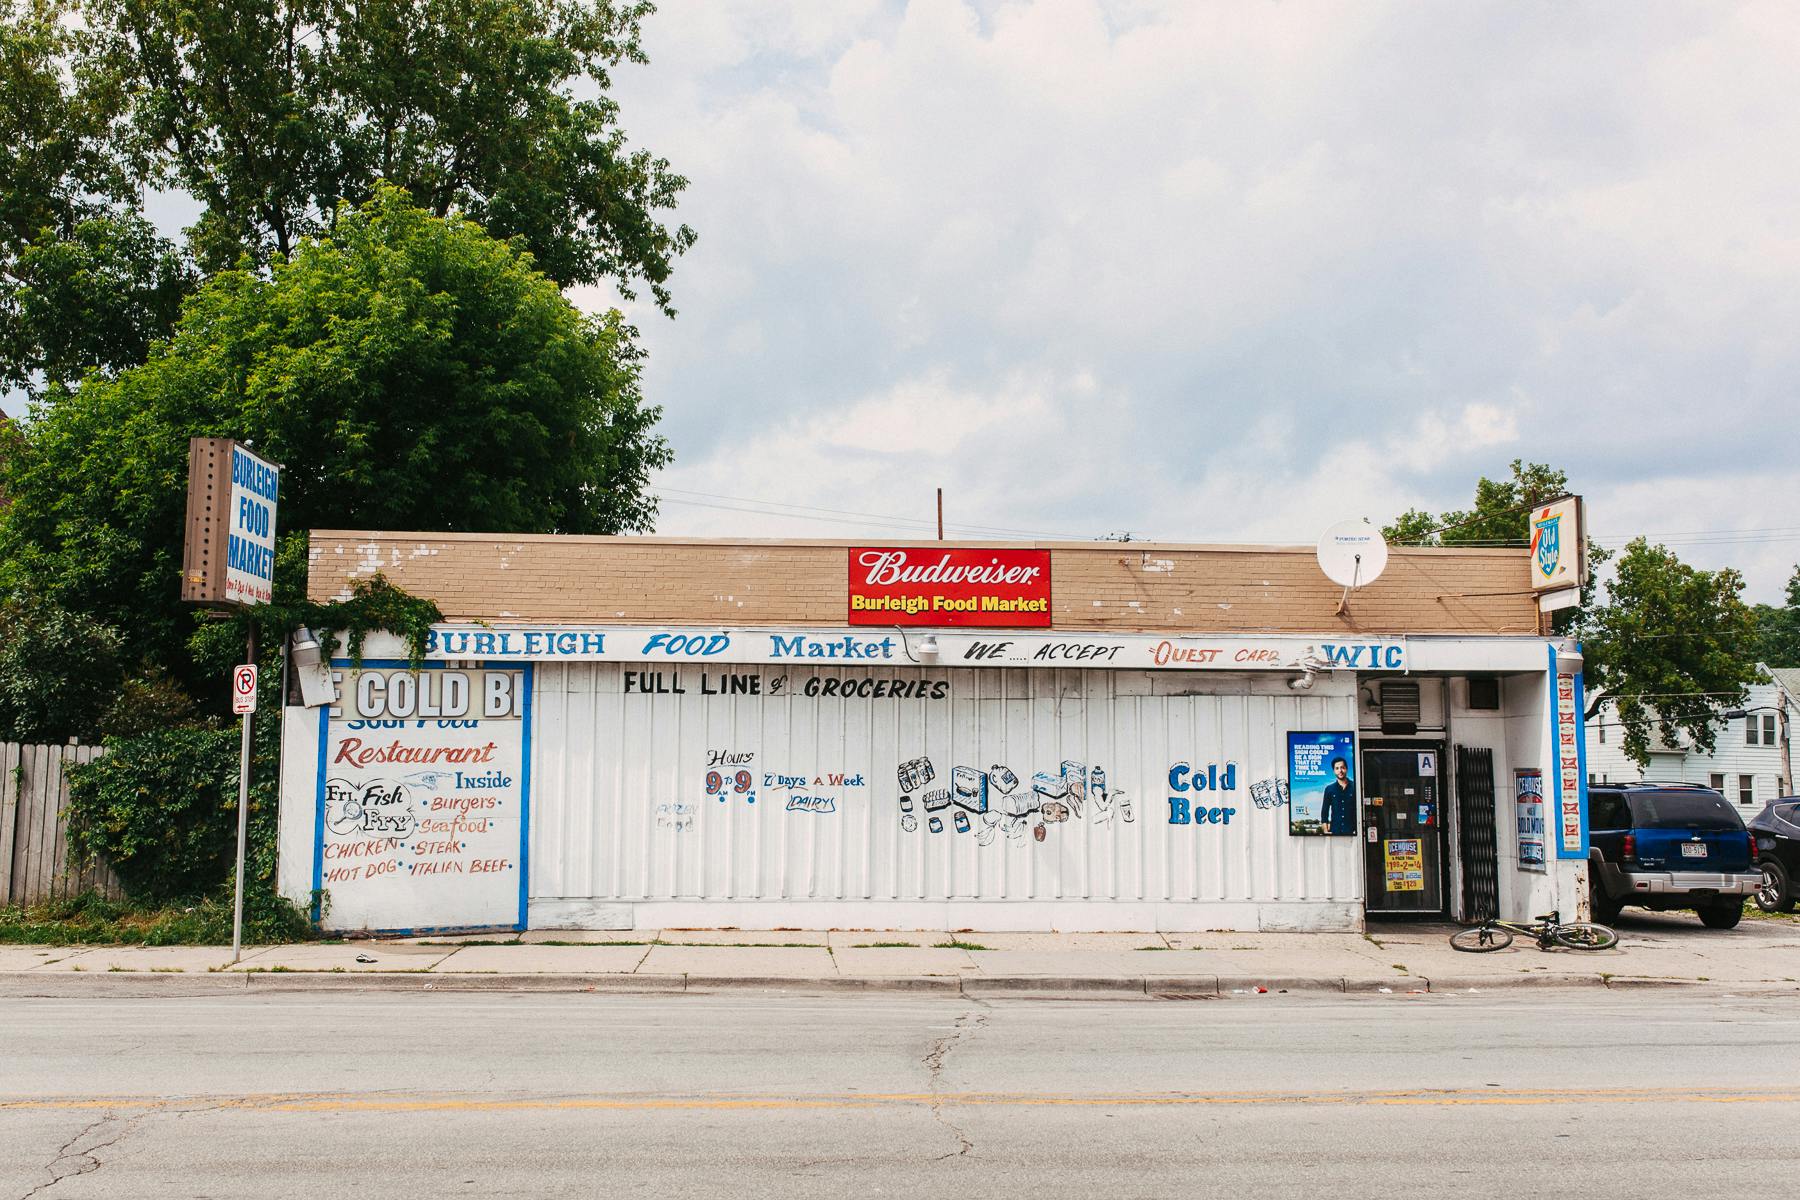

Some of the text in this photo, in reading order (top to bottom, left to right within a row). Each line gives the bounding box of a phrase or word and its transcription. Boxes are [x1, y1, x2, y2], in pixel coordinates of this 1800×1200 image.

[233, 449, 277, 503] BURLEIGH
[239, 497, 269, 538] FOOD
[1542, 525, 1556, 548] Old
[227, 534, 275, 581] MARKET
[859, 551, 1040, 586] Budweiser
[1540, 546, 1559, 573] Style
[851, 594, 1048, 614] Burleigh Food Market
[642, 633, 731, 656] FOOD
[769, 634, 897, 659] Market
[1033, 642, 1125, 661] ACCEPT
[1321, 644, 1403, 668] WIC
[357, 671, 470, 718] COLD
[624, 670, 950, 700] FULL LINE of GROCERIES
[334, 737, 498, 769] Restaurant
[707, 749, 754, 767] Hours
[1421, 756, 1432, 769] A
[455, 771, 512, 790] Inside
[705, 770, 723, 795] 9
[733, 769, 753, 794] 9
[764, 772, 865, 790] 7 Days A Week
[1168, 761, 1237, 793] Cold
[1517, 776, 1543, 797] ICEHOUSE
[362, 785, 403, 807] Fish
[431, 796, 496, 814] Burgers
[1168, 797, 1237, 825] Beer
[418, 815, 488, 841] Seafood
[324, 838, 398, 860] CHICKEN
[414, 840, 462, 856] STEAK
[1388, 841, 1417, 853] ICEHOUSE
[328, 859, 397, 883] HOT DOG
[411, 858, 508, 877] ITALIAN BEEF
